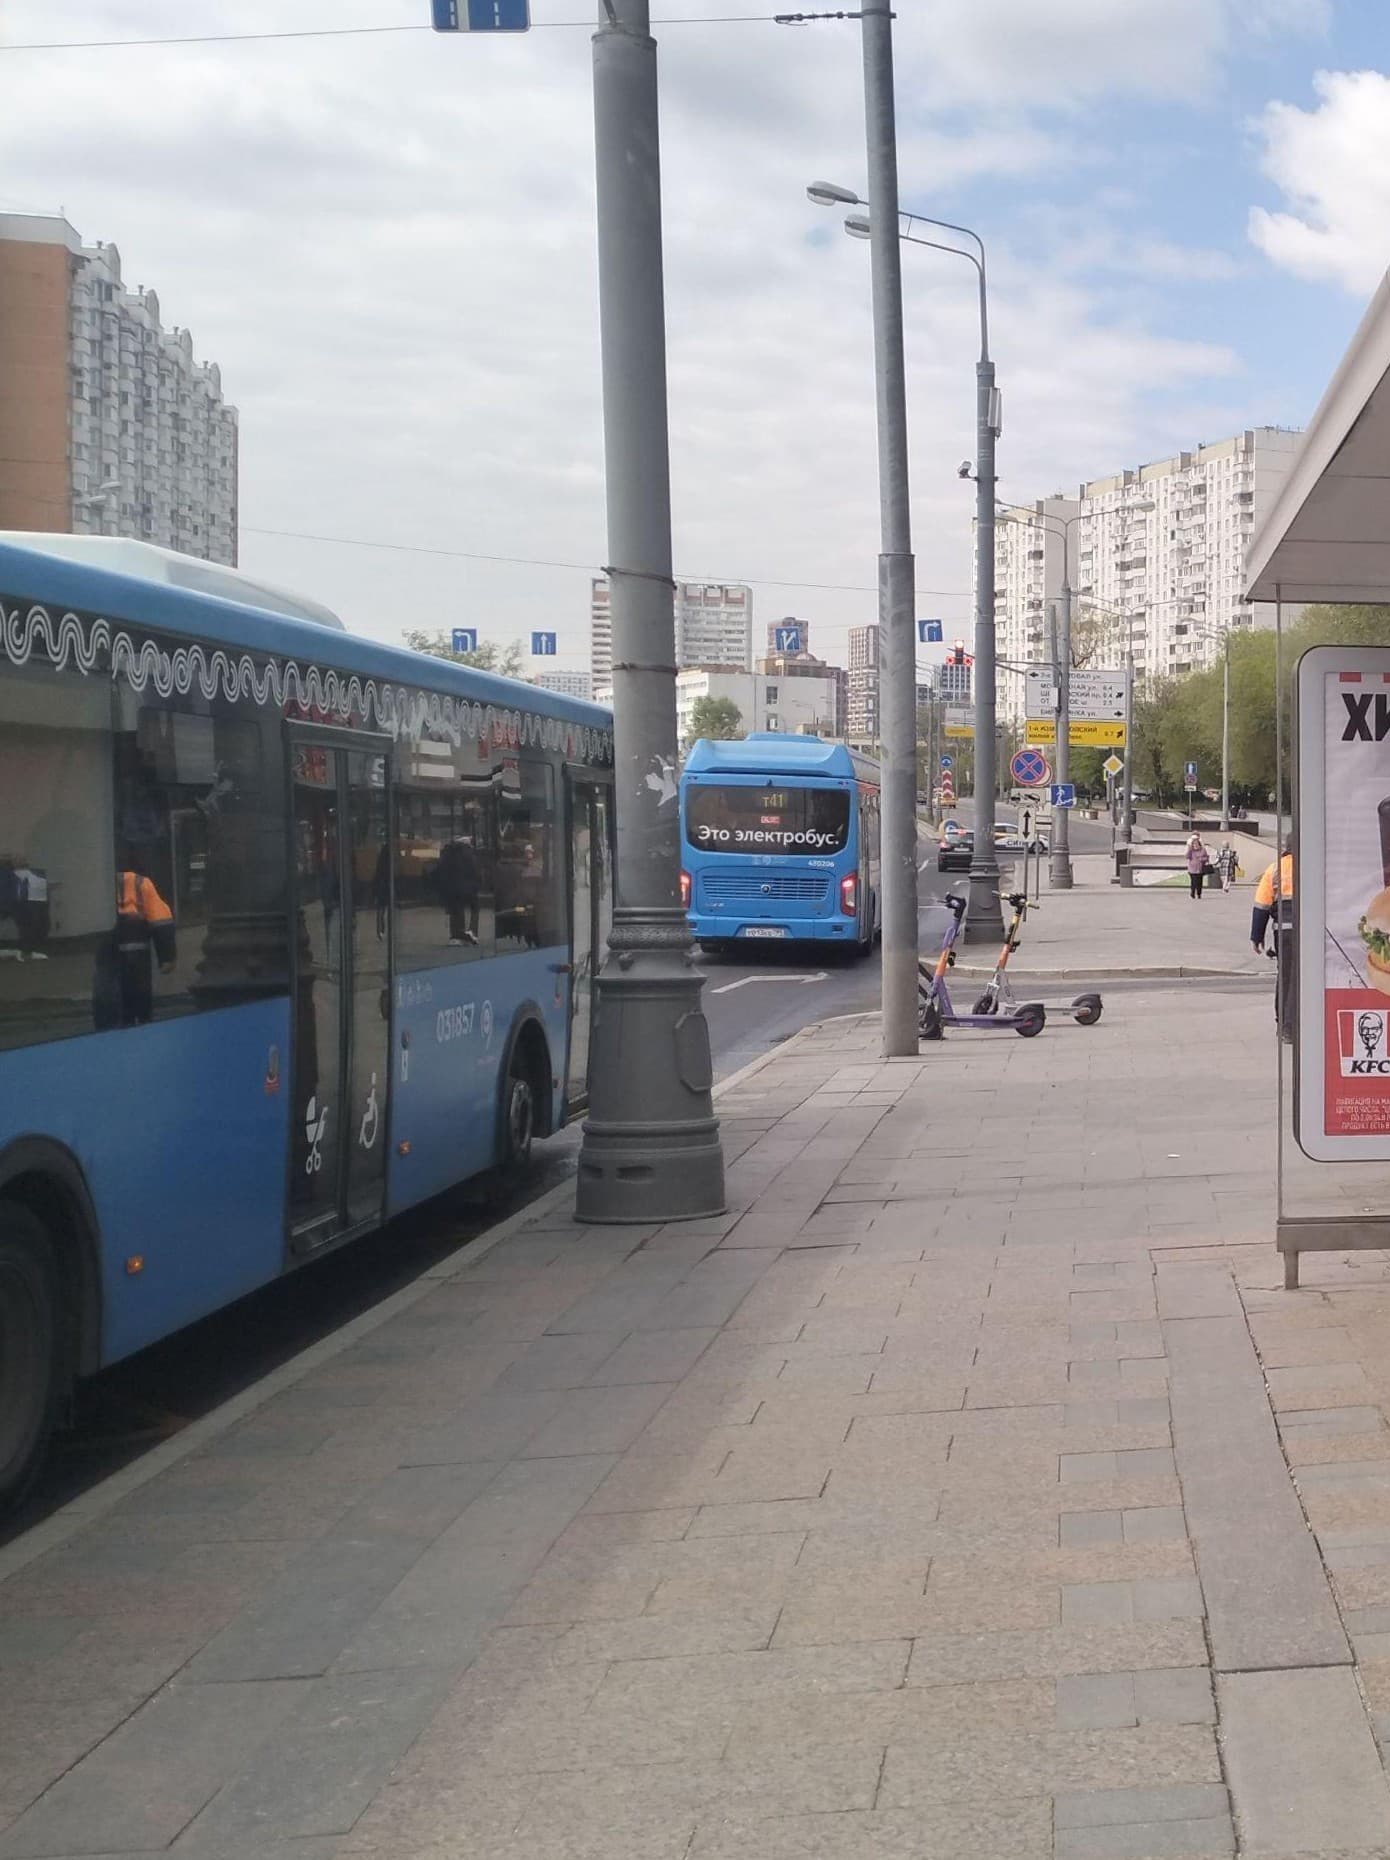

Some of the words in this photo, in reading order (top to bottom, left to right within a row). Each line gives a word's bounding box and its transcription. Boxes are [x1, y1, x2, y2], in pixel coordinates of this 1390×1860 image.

[698, 825, 730, 841] Это
[735, 829, 839, 848] электробус.
[1350, 1059, 1390, 1074] KFC
